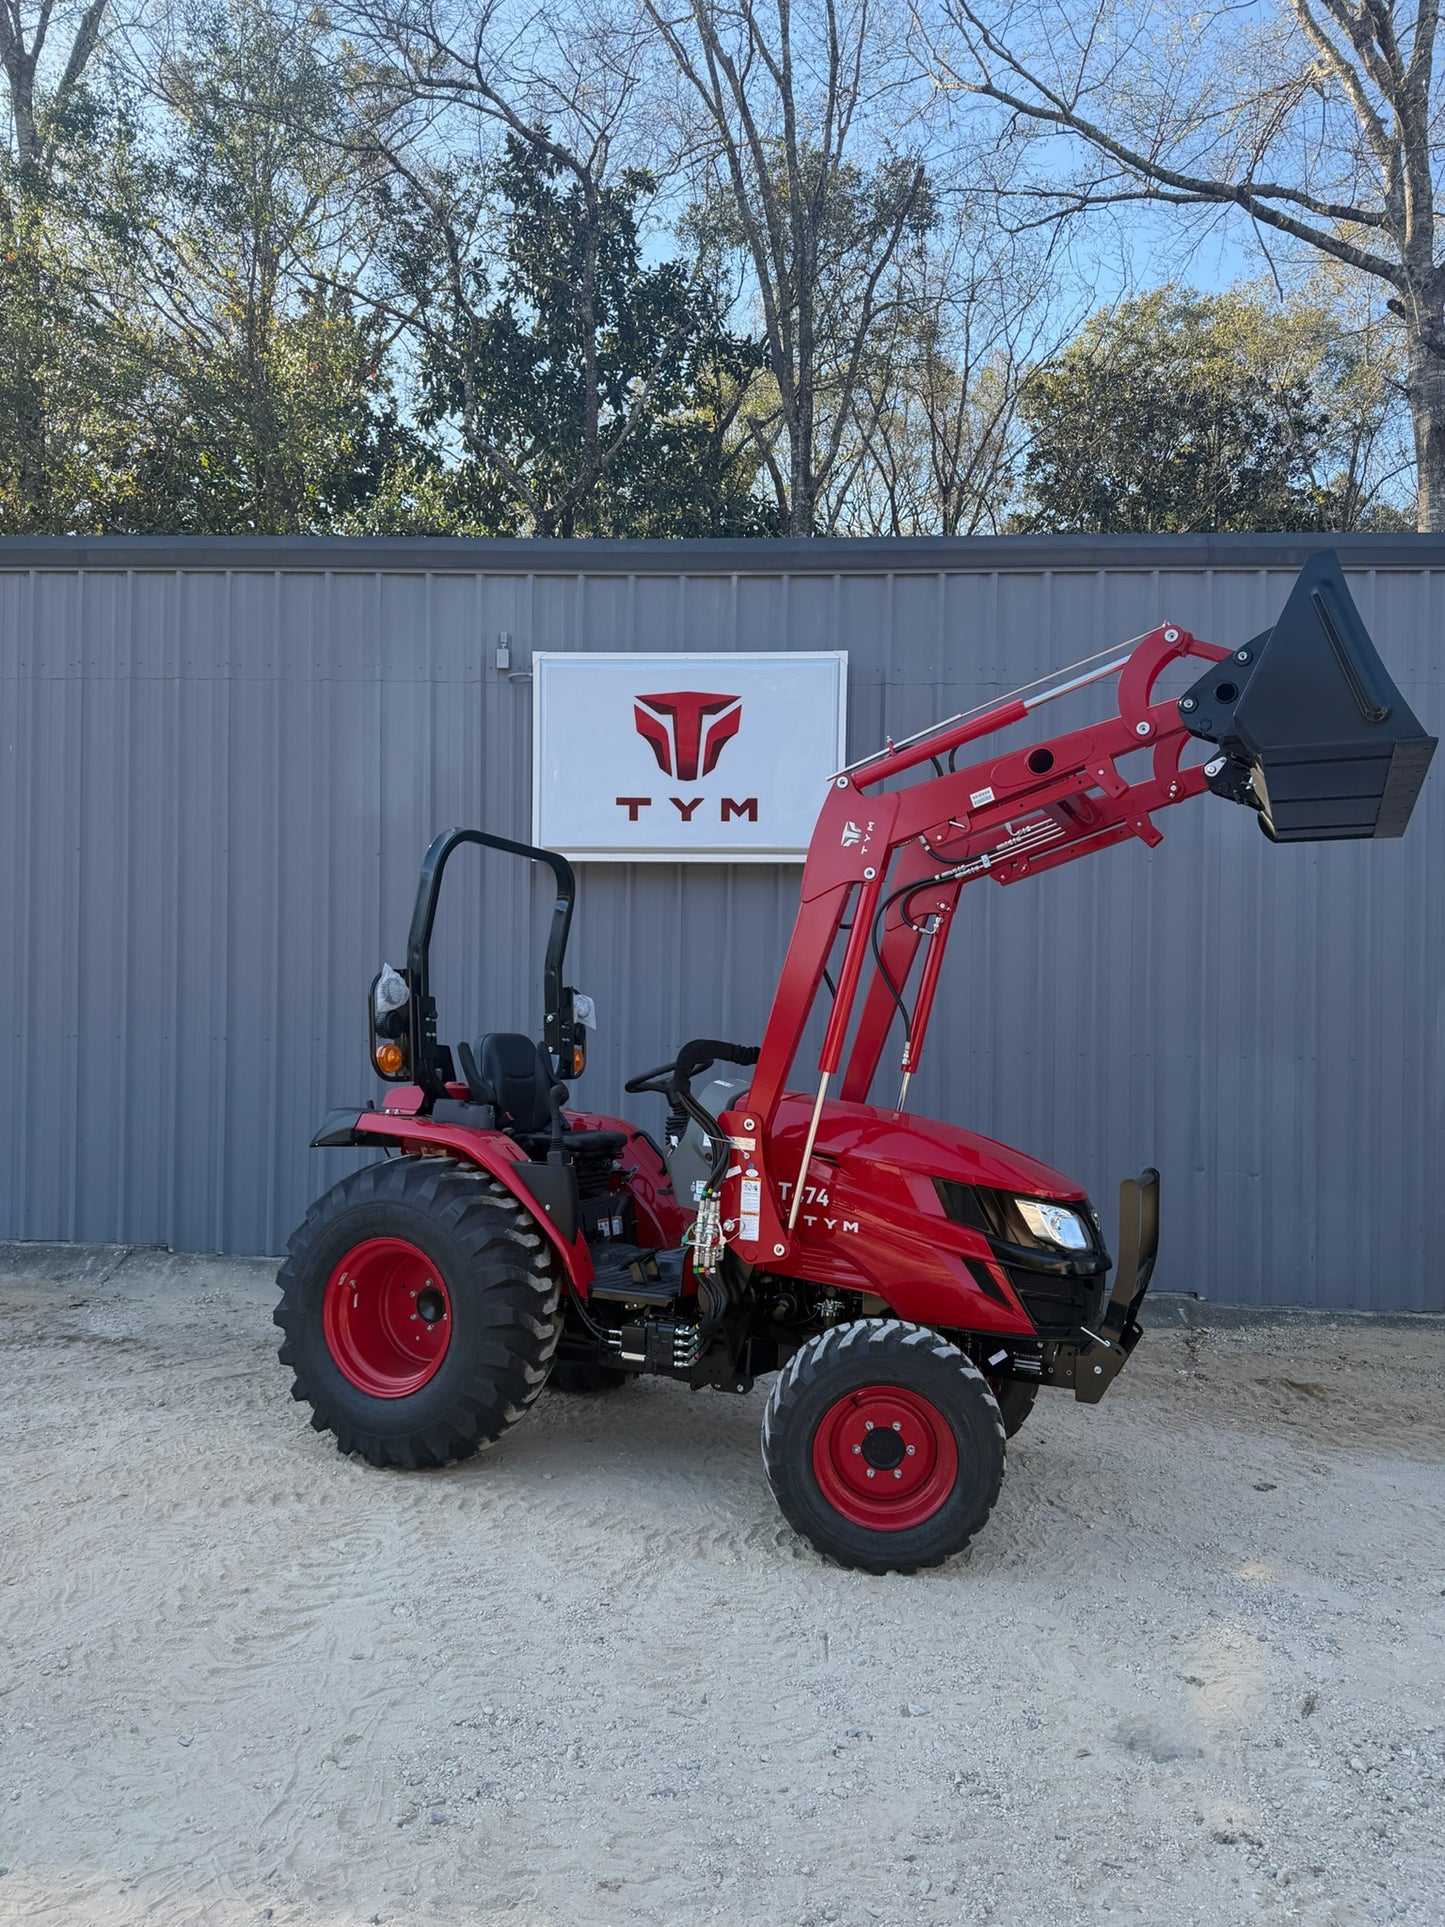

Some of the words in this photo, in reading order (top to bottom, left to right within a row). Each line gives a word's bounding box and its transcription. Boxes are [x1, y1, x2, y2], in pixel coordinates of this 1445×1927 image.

[616, 797, 758, 822] TYM
[861, 821, 875, 855] TYM
[803, 1215, 859, 1233] TYM
